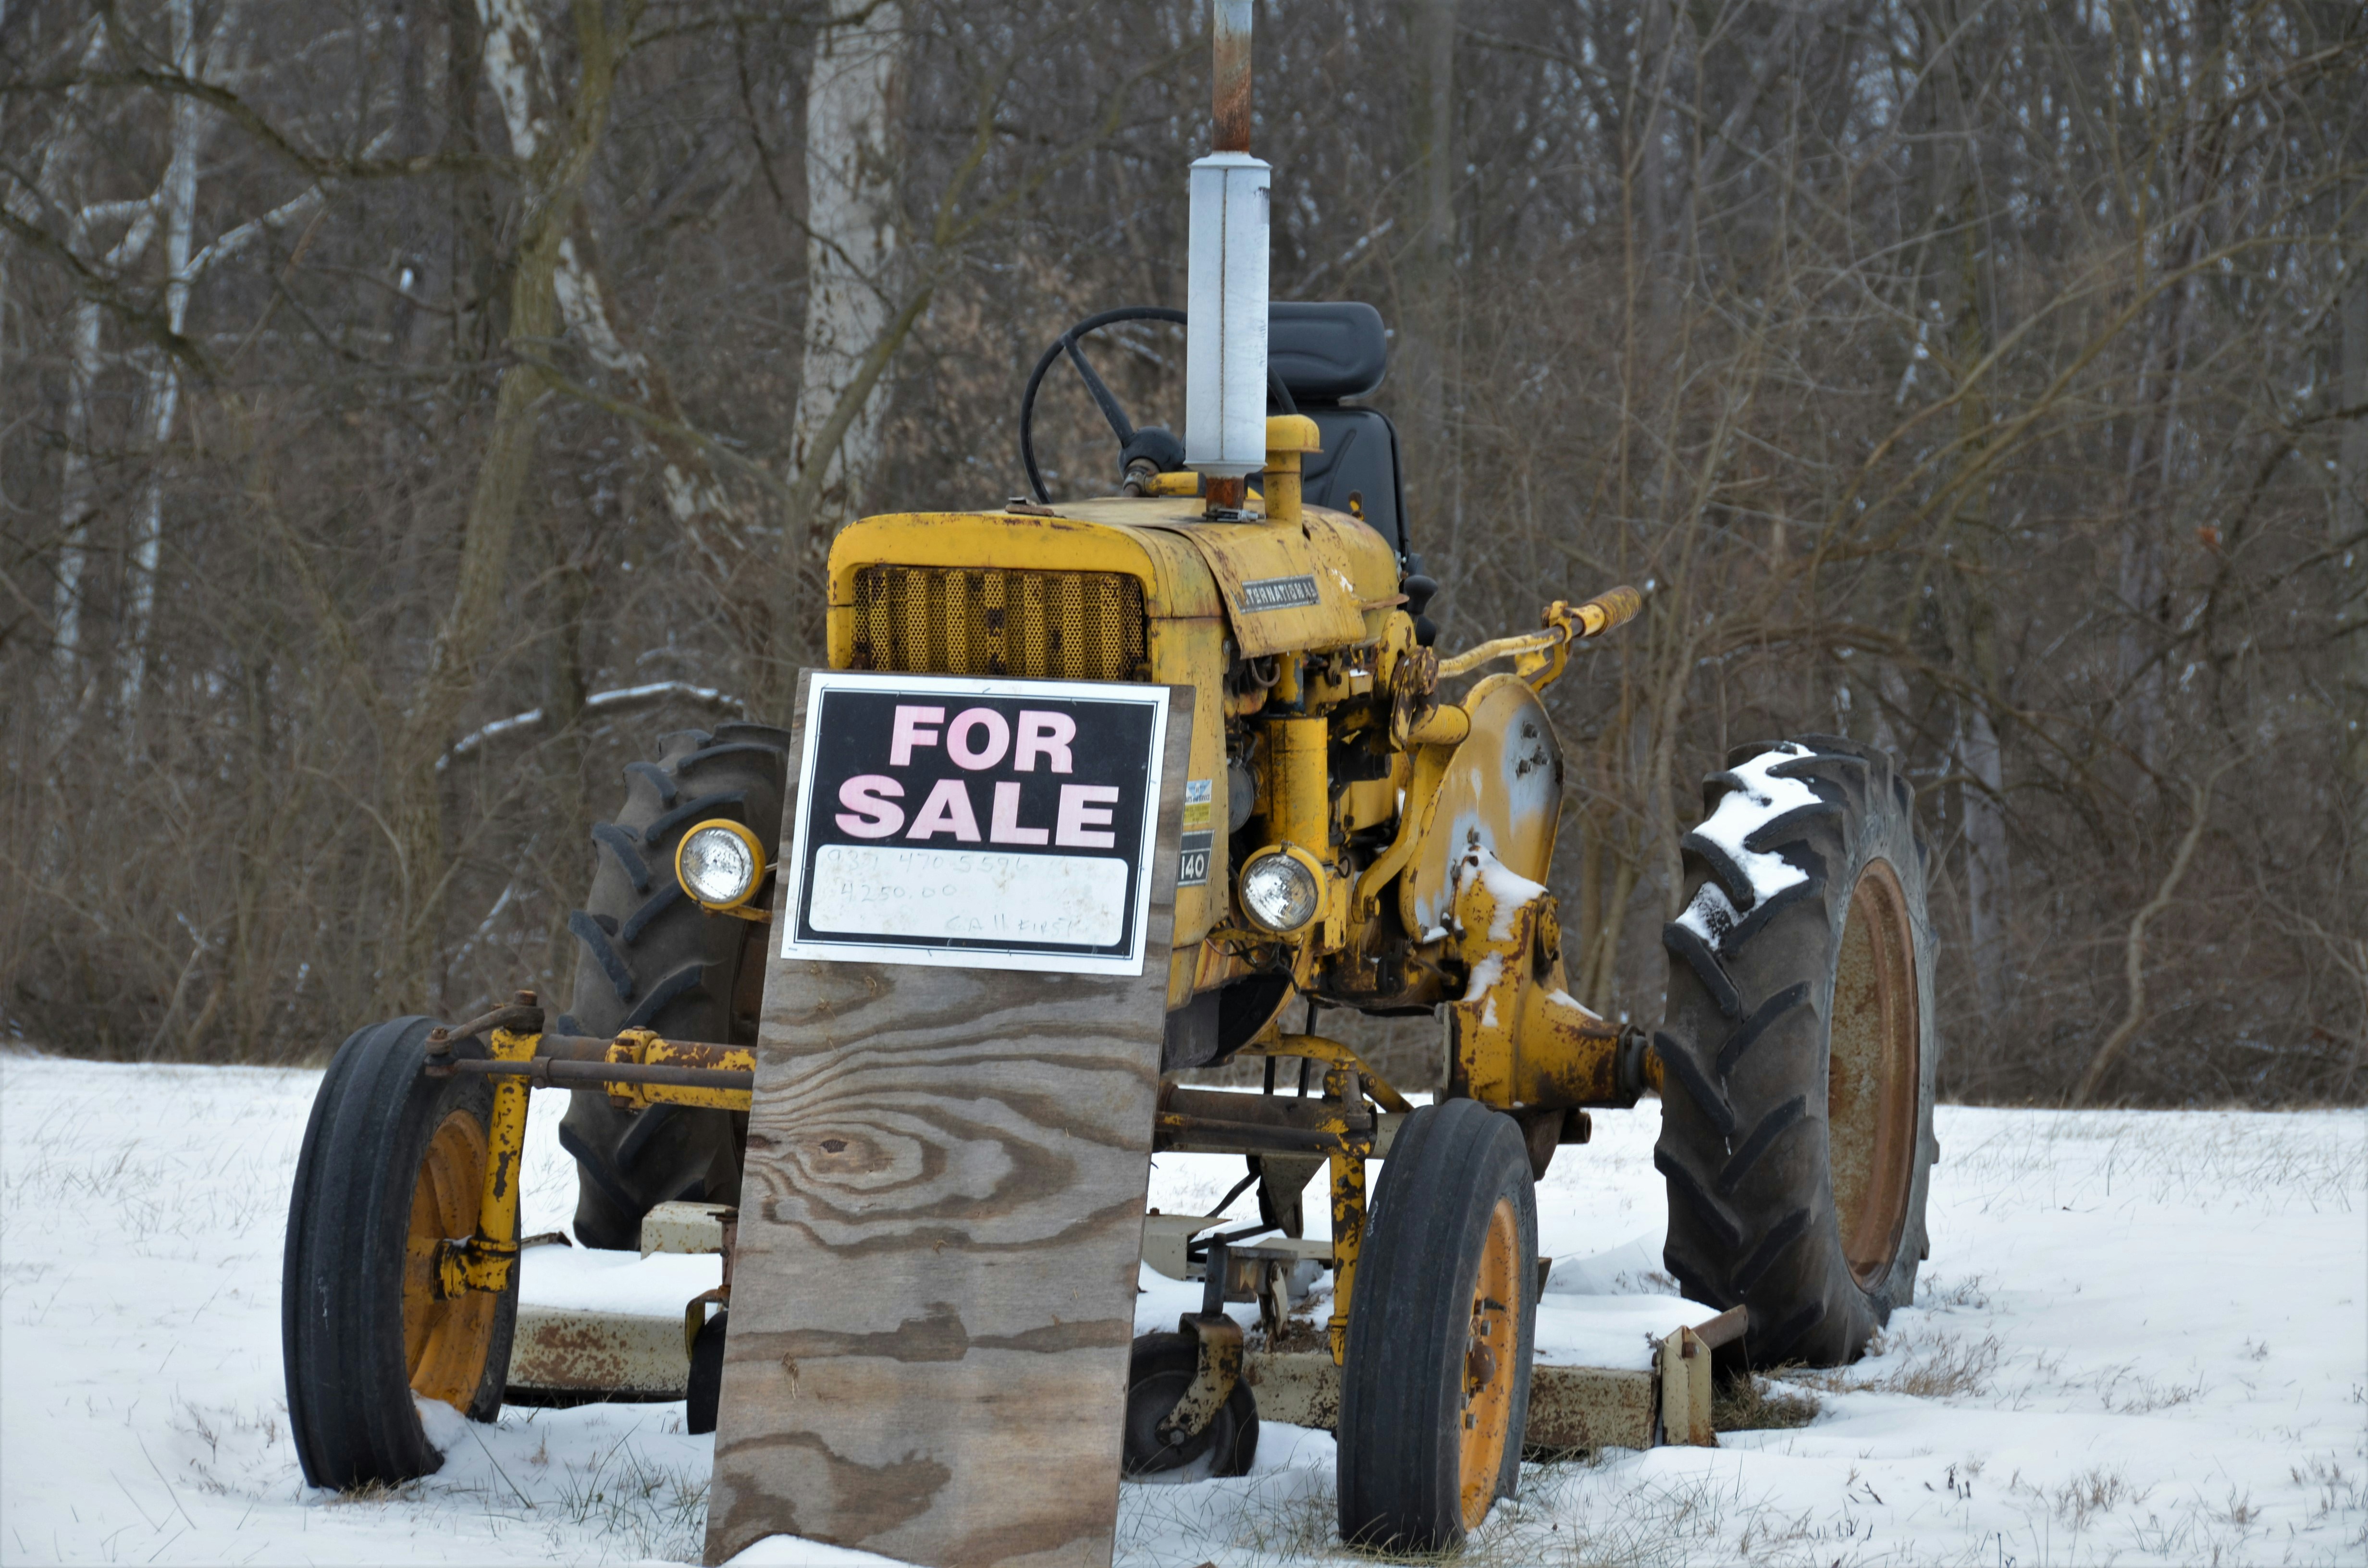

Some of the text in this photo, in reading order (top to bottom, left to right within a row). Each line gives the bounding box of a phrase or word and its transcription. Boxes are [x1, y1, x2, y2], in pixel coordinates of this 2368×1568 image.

[1246, 582, 1317, 606] TERNATIONAL
[889, 705, 1076, 773] FOR
[835, 774, 1119, 849] SALE
[900, 853, 944, 873] 470
[1181, 853, 1204, 880] 140
[841, 883, 957, 903] 4250.00
